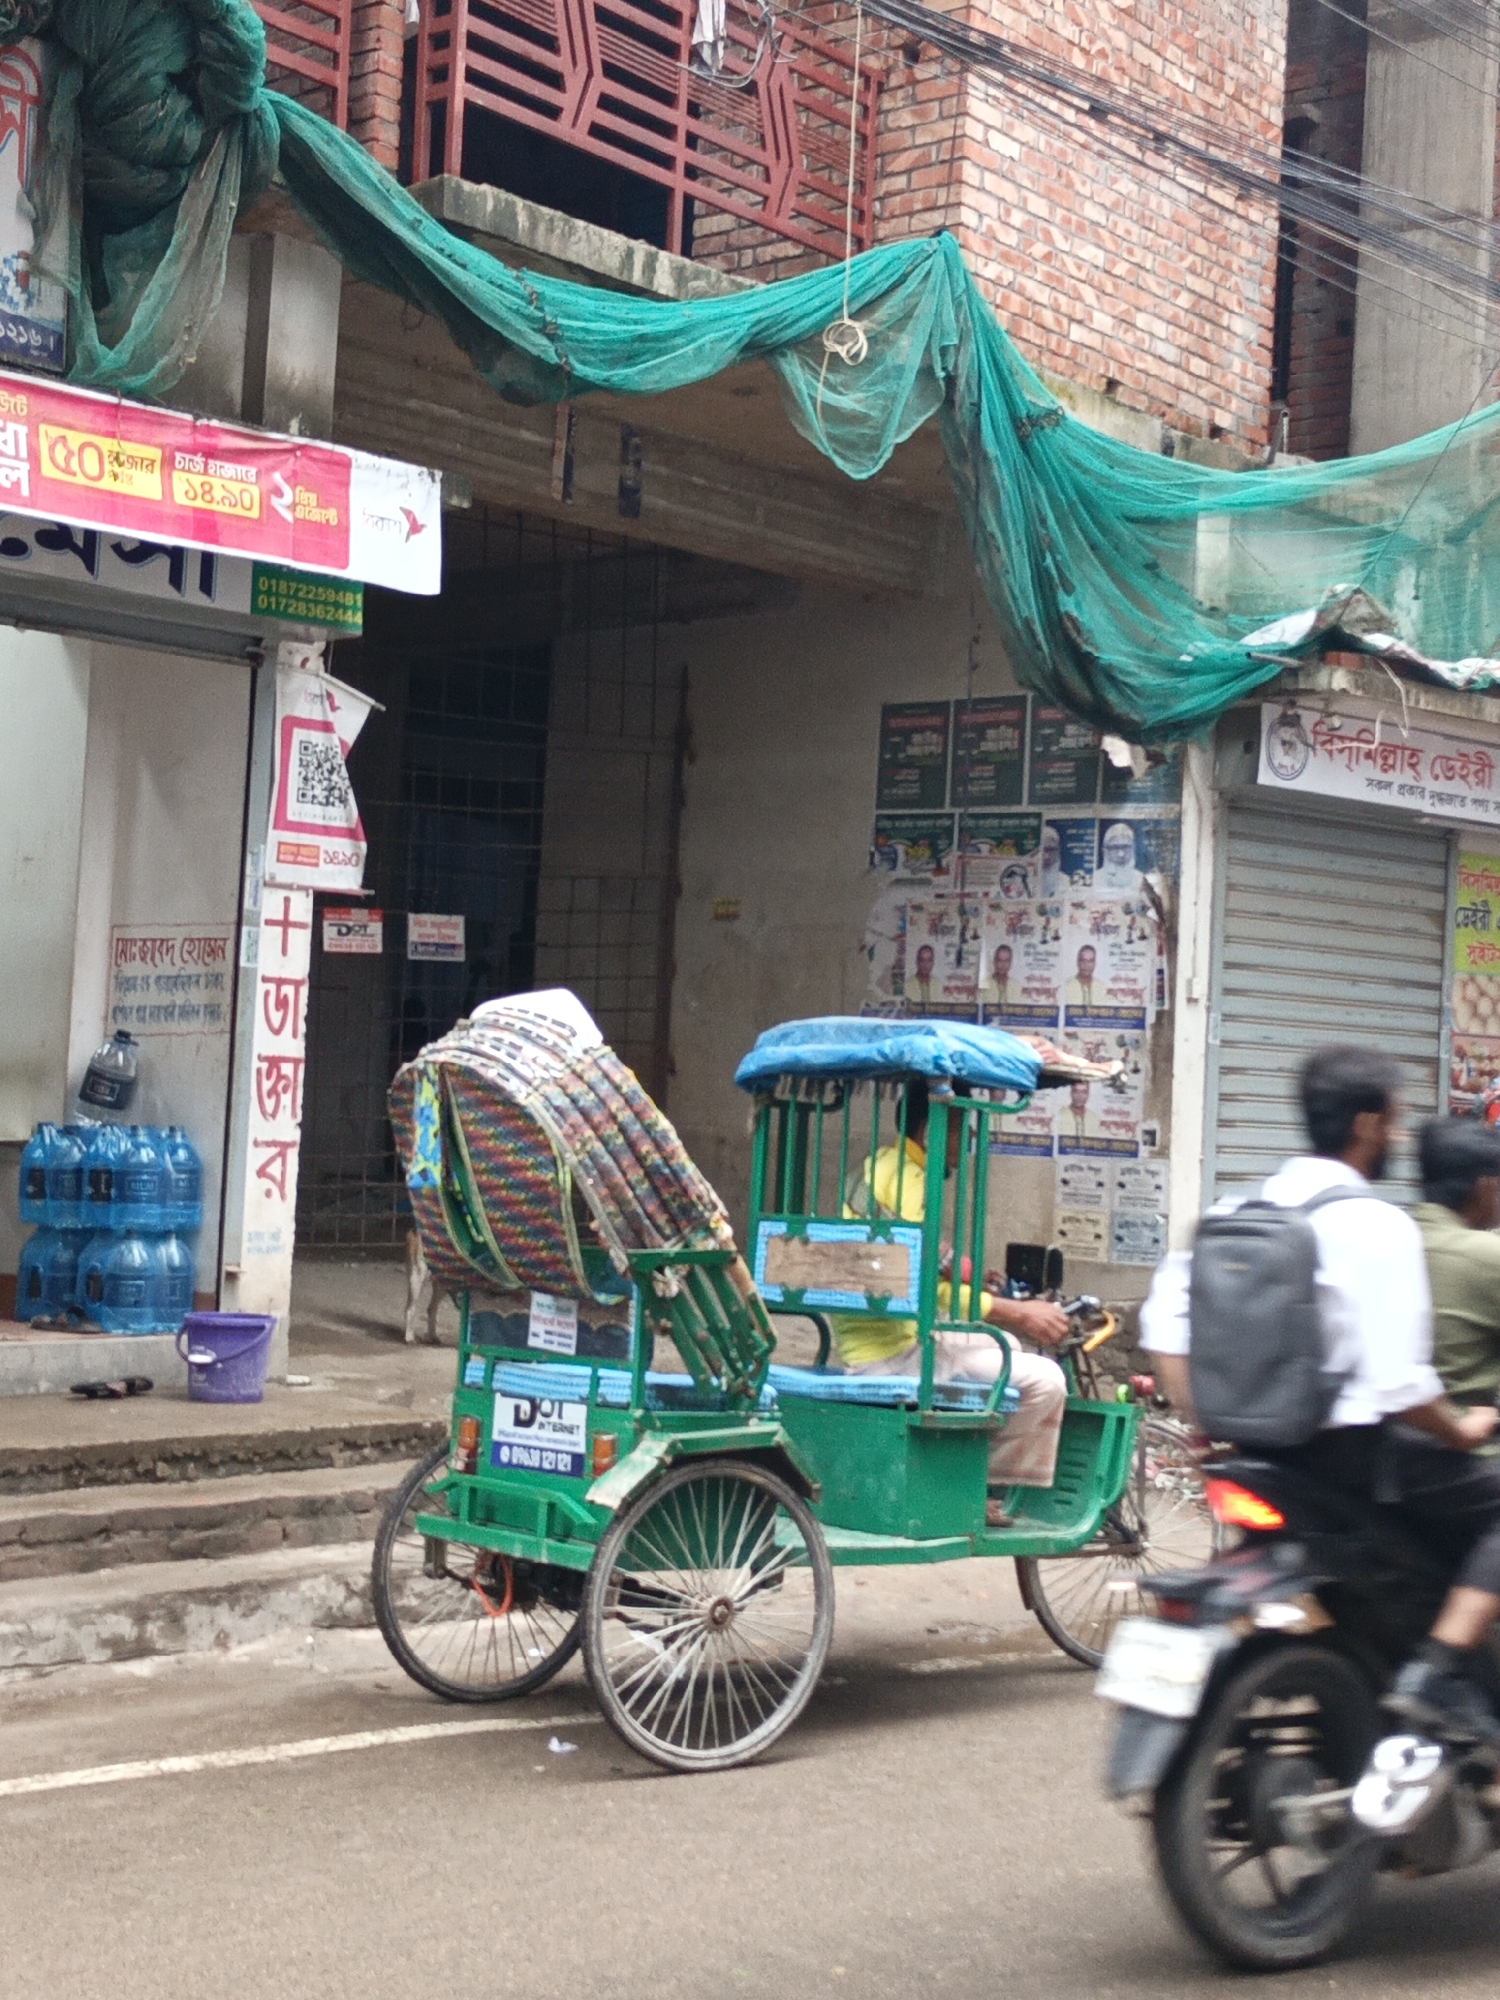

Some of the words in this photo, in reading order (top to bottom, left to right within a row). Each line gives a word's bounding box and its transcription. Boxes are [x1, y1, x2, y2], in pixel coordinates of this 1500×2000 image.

[175, 451, 206, 474] চার্জ
[207, 458, 257, 484] হাজারে
[271, 471, 294, 524] ২
